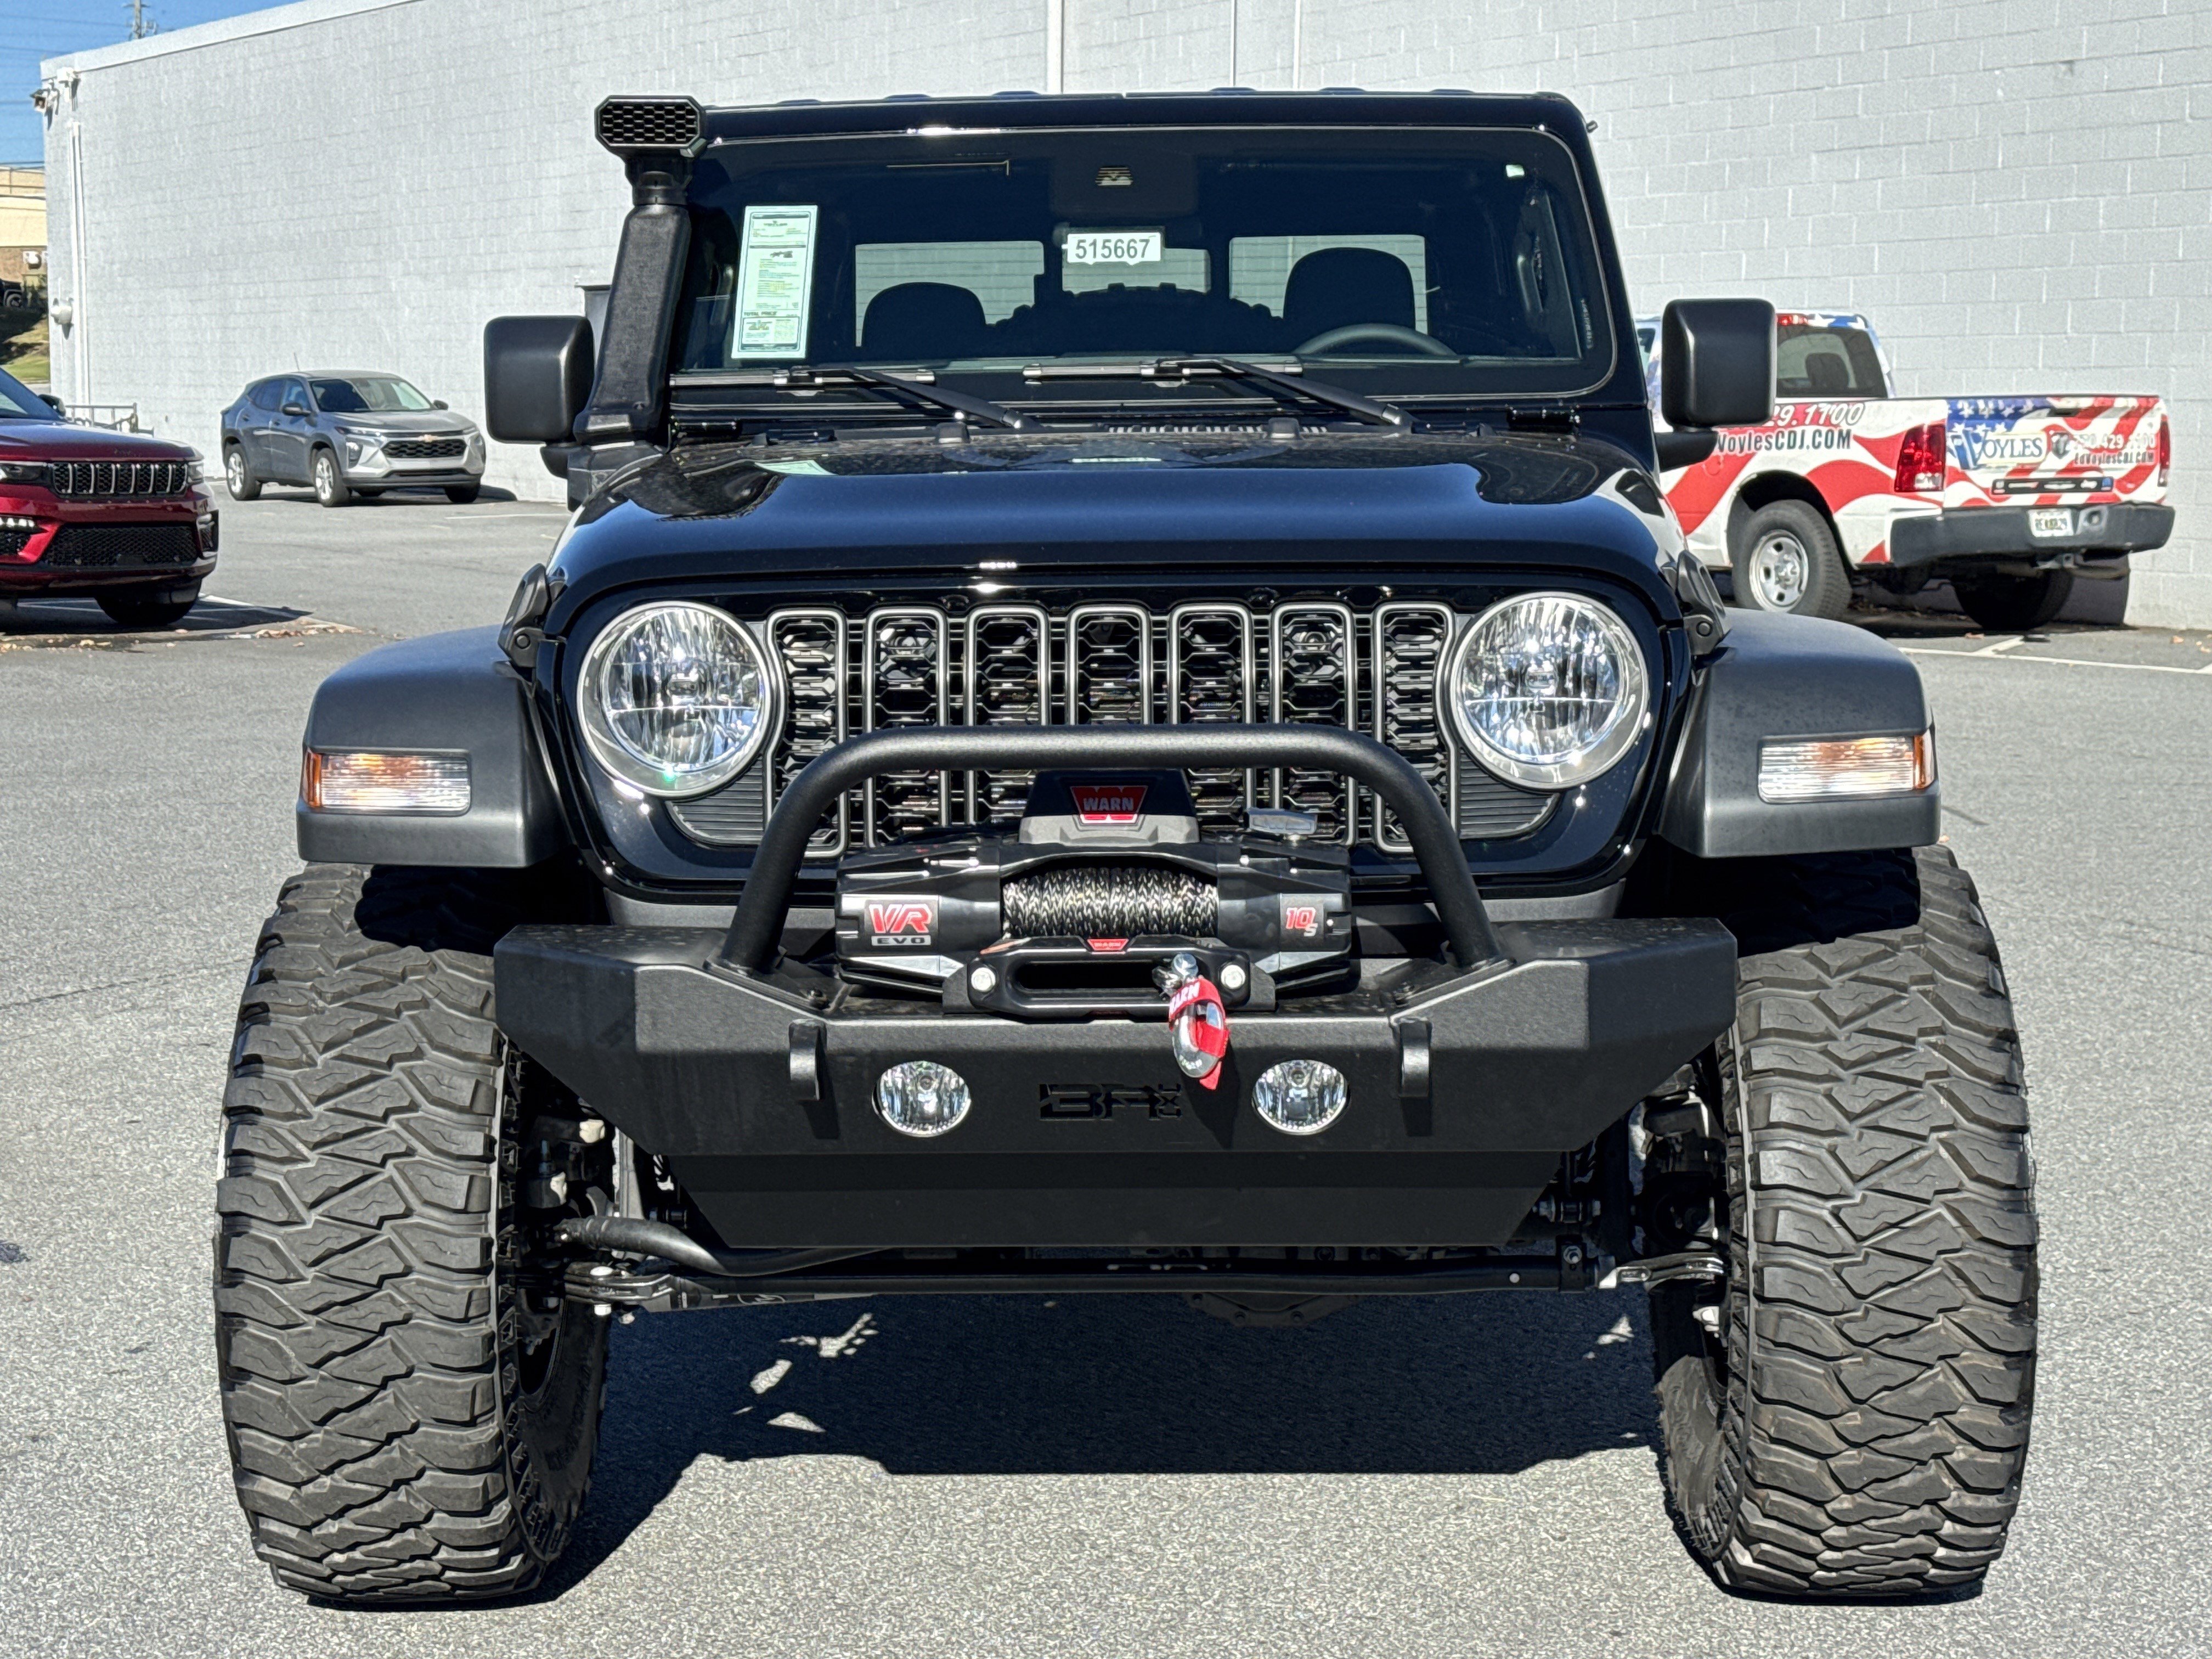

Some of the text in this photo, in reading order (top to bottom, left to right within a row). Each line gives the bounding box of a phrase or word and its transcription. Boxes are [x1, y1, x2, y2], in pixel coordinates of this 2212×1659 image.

[1075, 238, 1150, 258] 515667
[1962, 430, 2042, 466] VOYLES
[1083, 797, 1134, 811] WARN
[869, 904, 932, 933] VR
